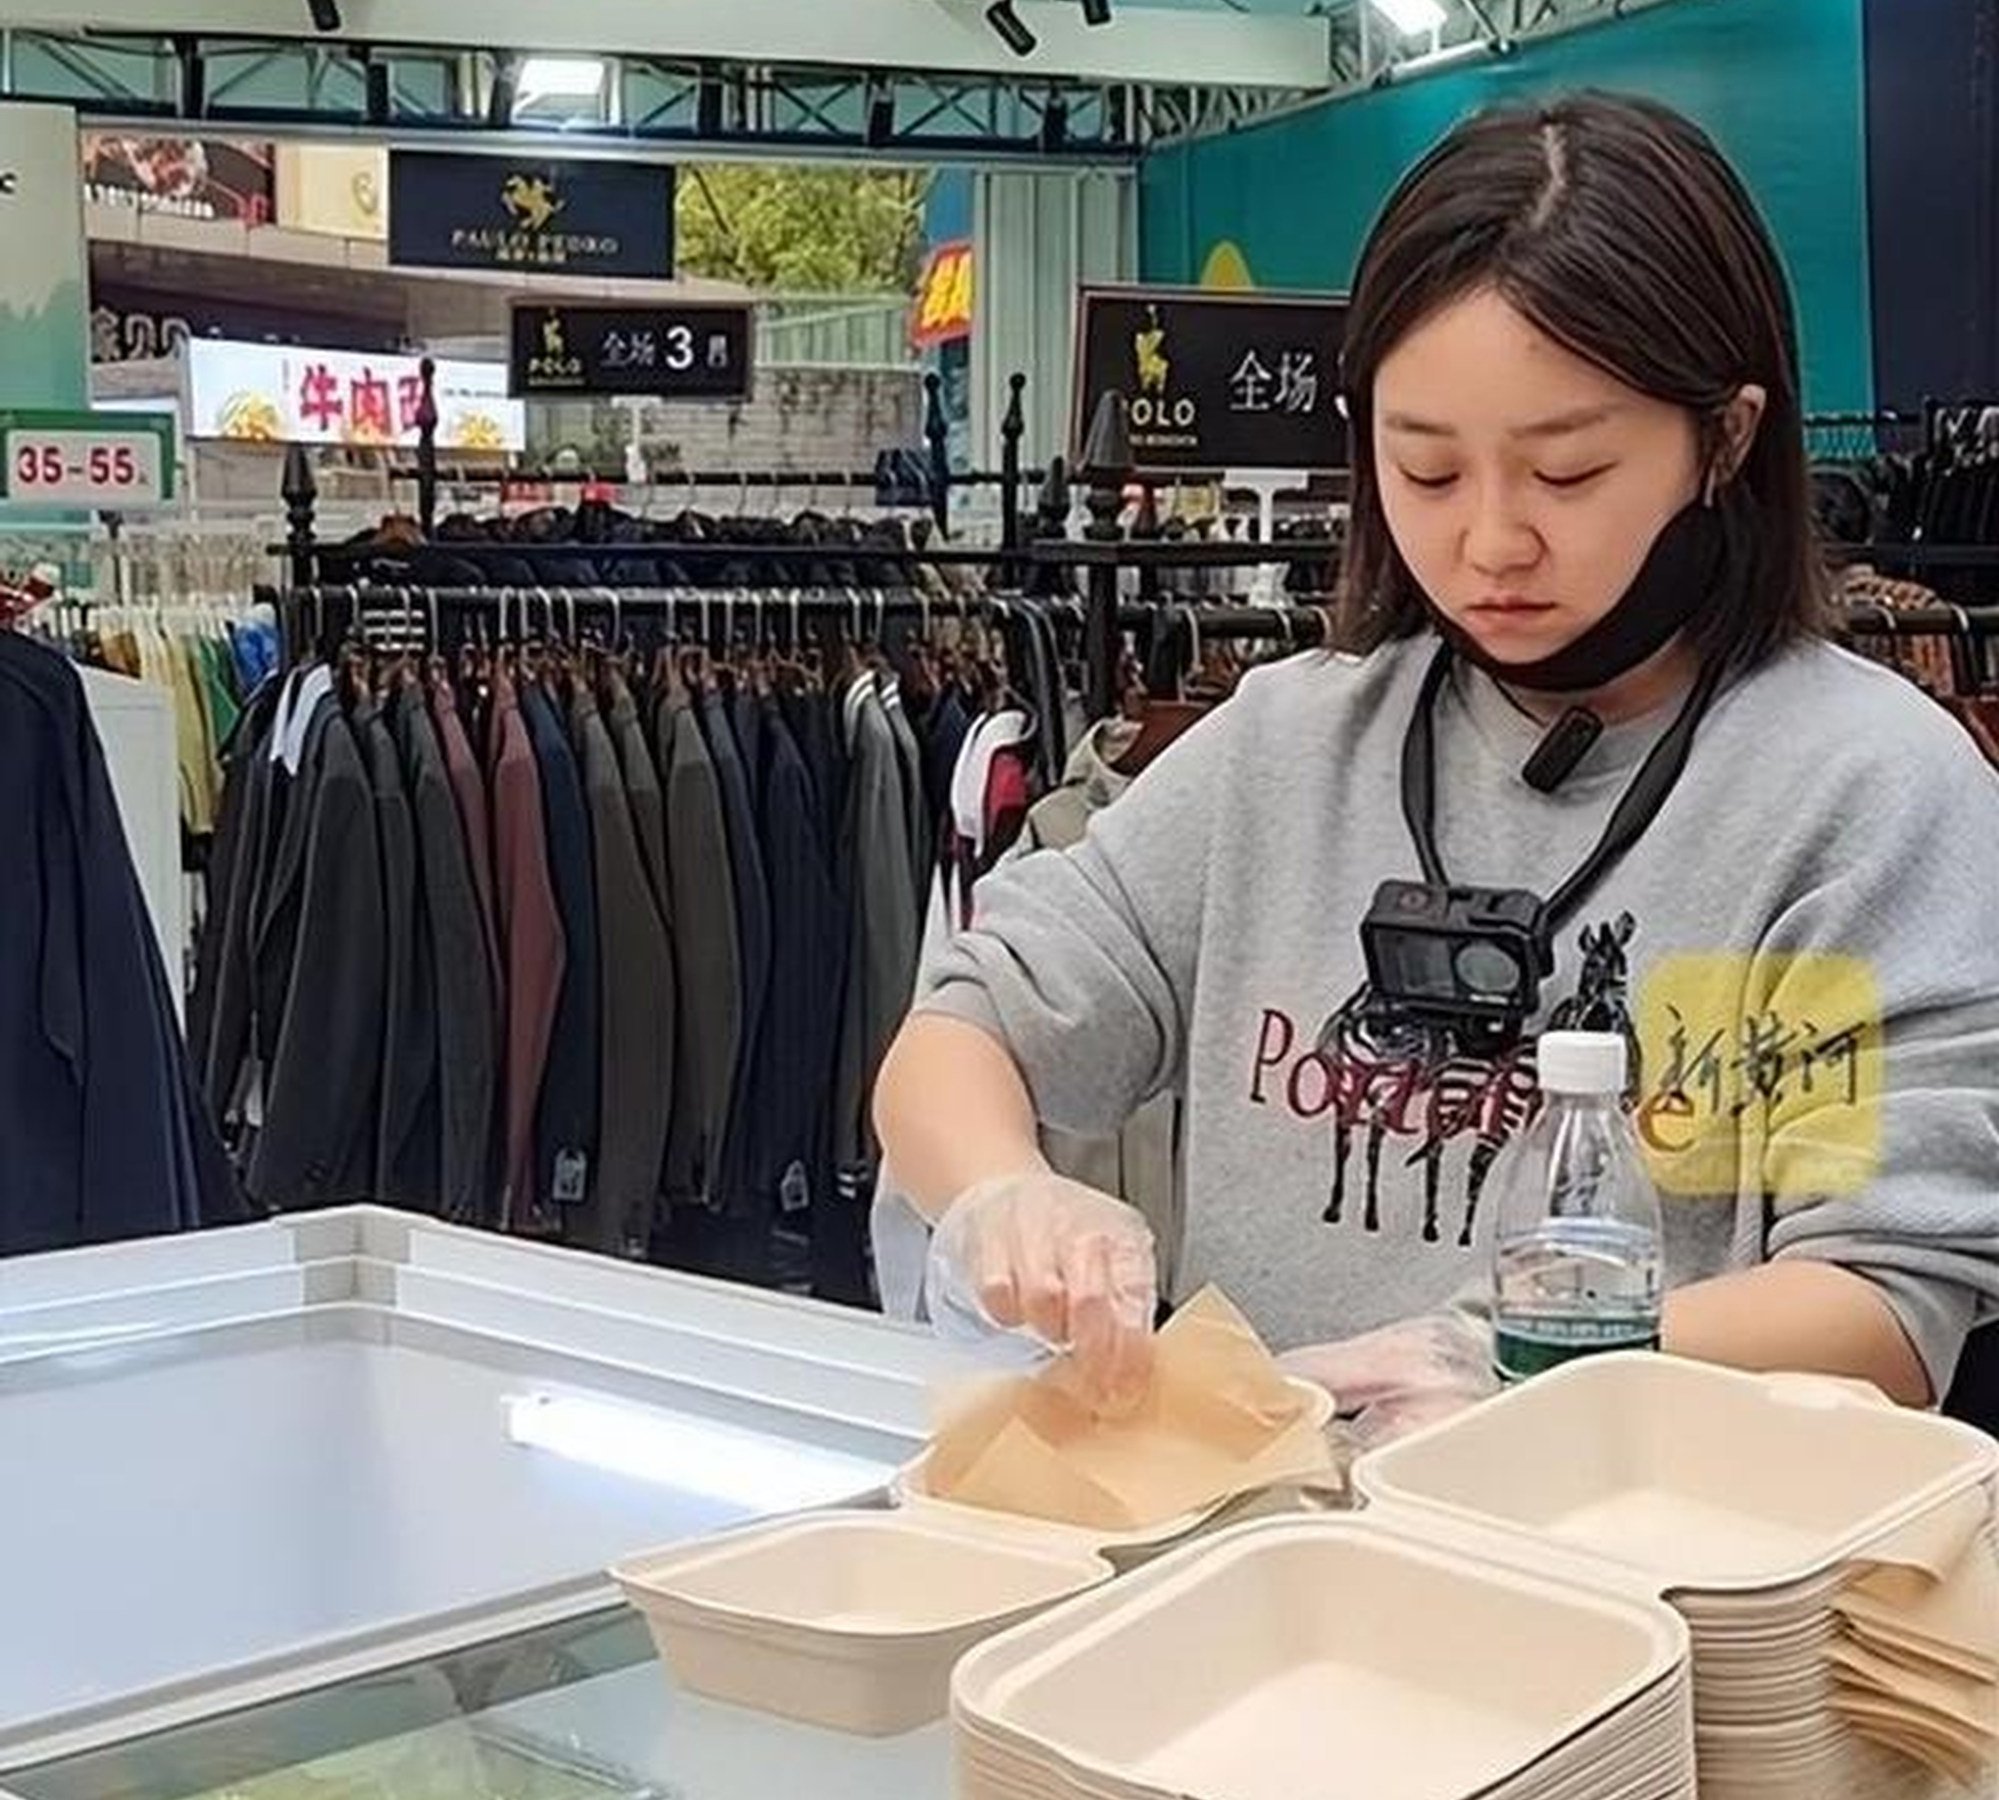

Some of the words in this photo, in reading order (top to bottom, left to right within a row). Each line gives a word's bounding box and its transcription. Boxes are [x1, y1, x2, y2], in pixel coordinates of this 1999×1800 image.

[666, 325, 693, 370] 3
[1230, 350, 1317, 412] 全场
[1122, 398, 1195, 426] OLO
[18, 446, 134, 484] 35-55
